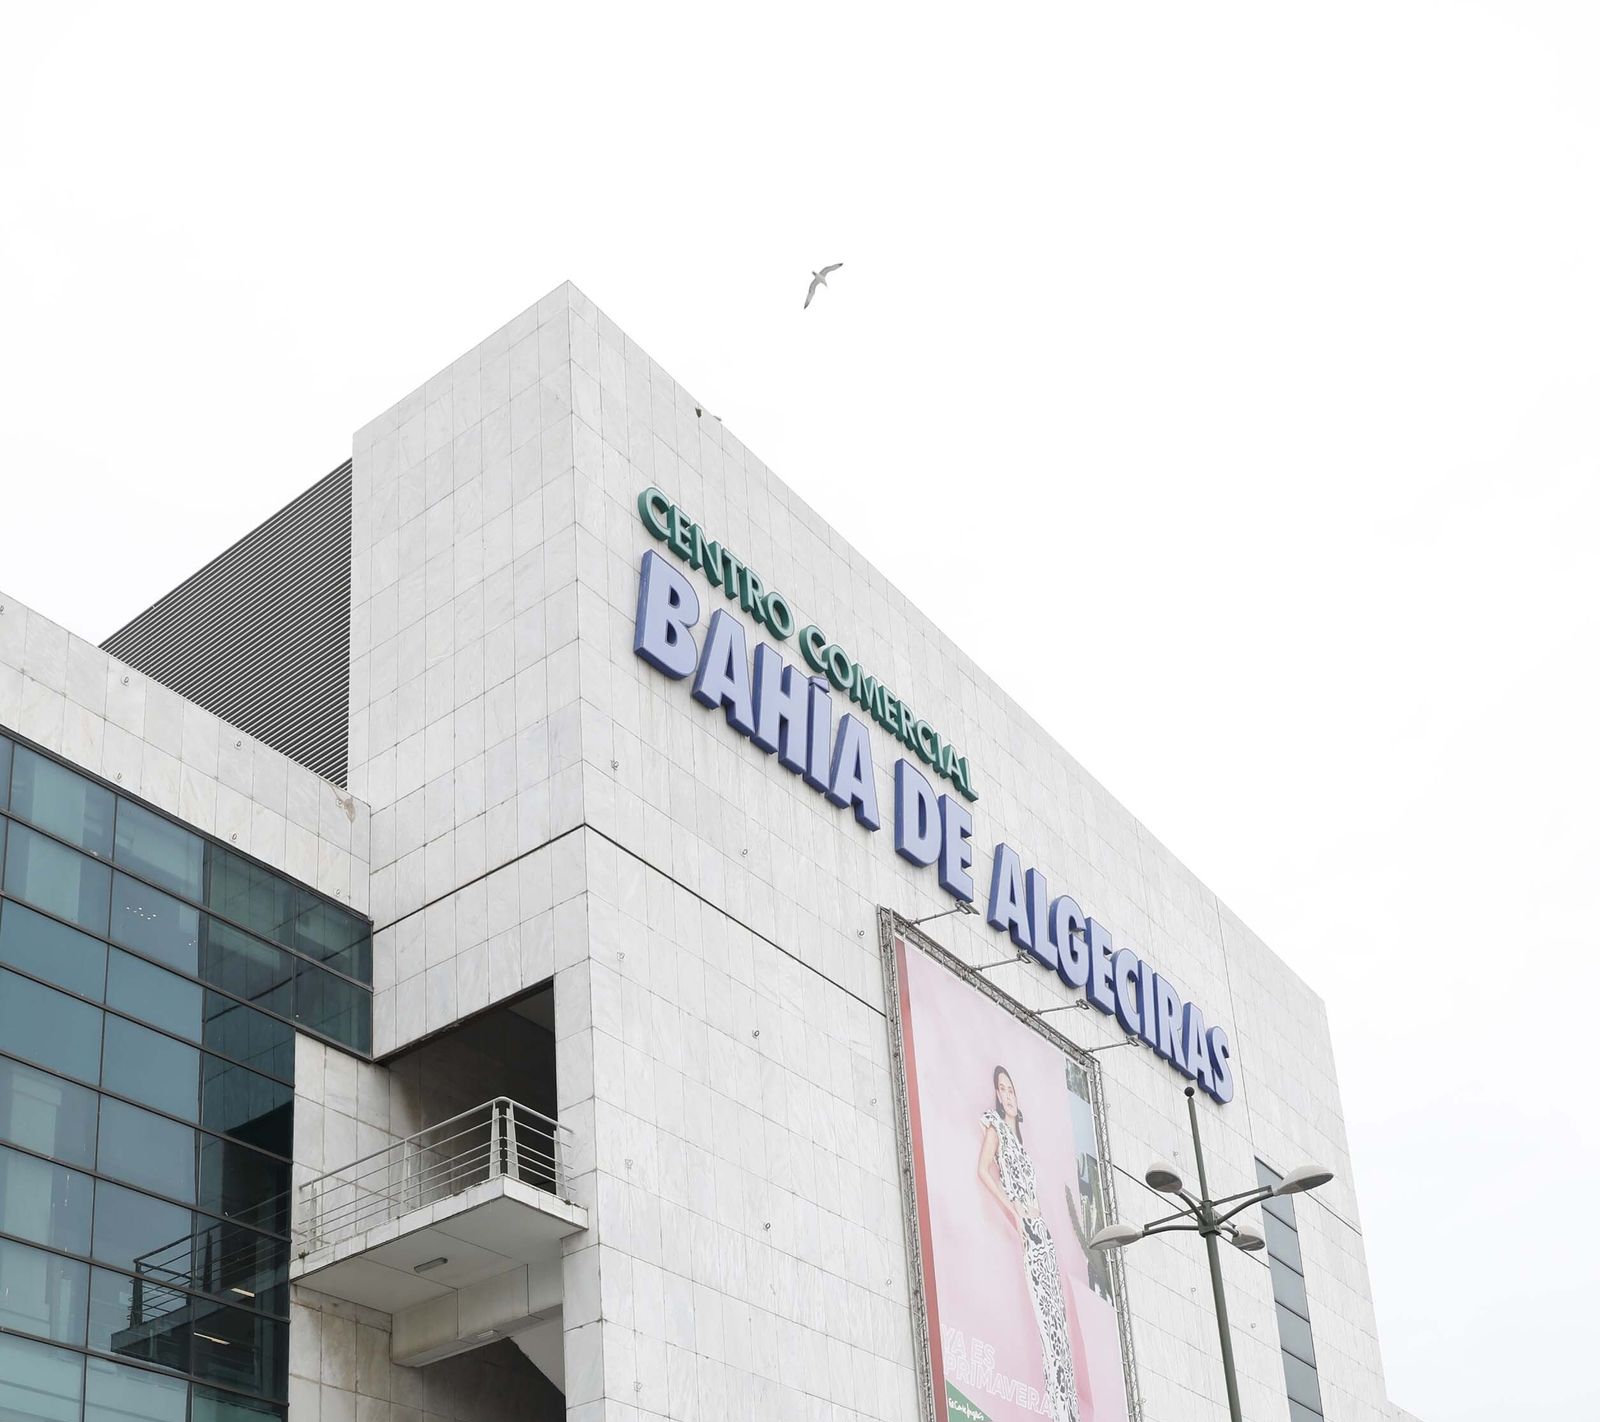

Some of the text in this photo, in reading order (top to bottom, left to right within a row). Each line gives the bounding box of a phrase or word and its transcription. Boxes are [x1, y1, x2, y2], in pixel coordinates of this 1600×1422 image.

[638, 486, 979, 802] CENTRO COMERCIAL
[634, 549, 1234, 1105] BAHÍA DE ALGECIRAS
[941, 1322, 996, 1369] YA ES
[944, 1351, 1054, 1419] PRIMAVERA
